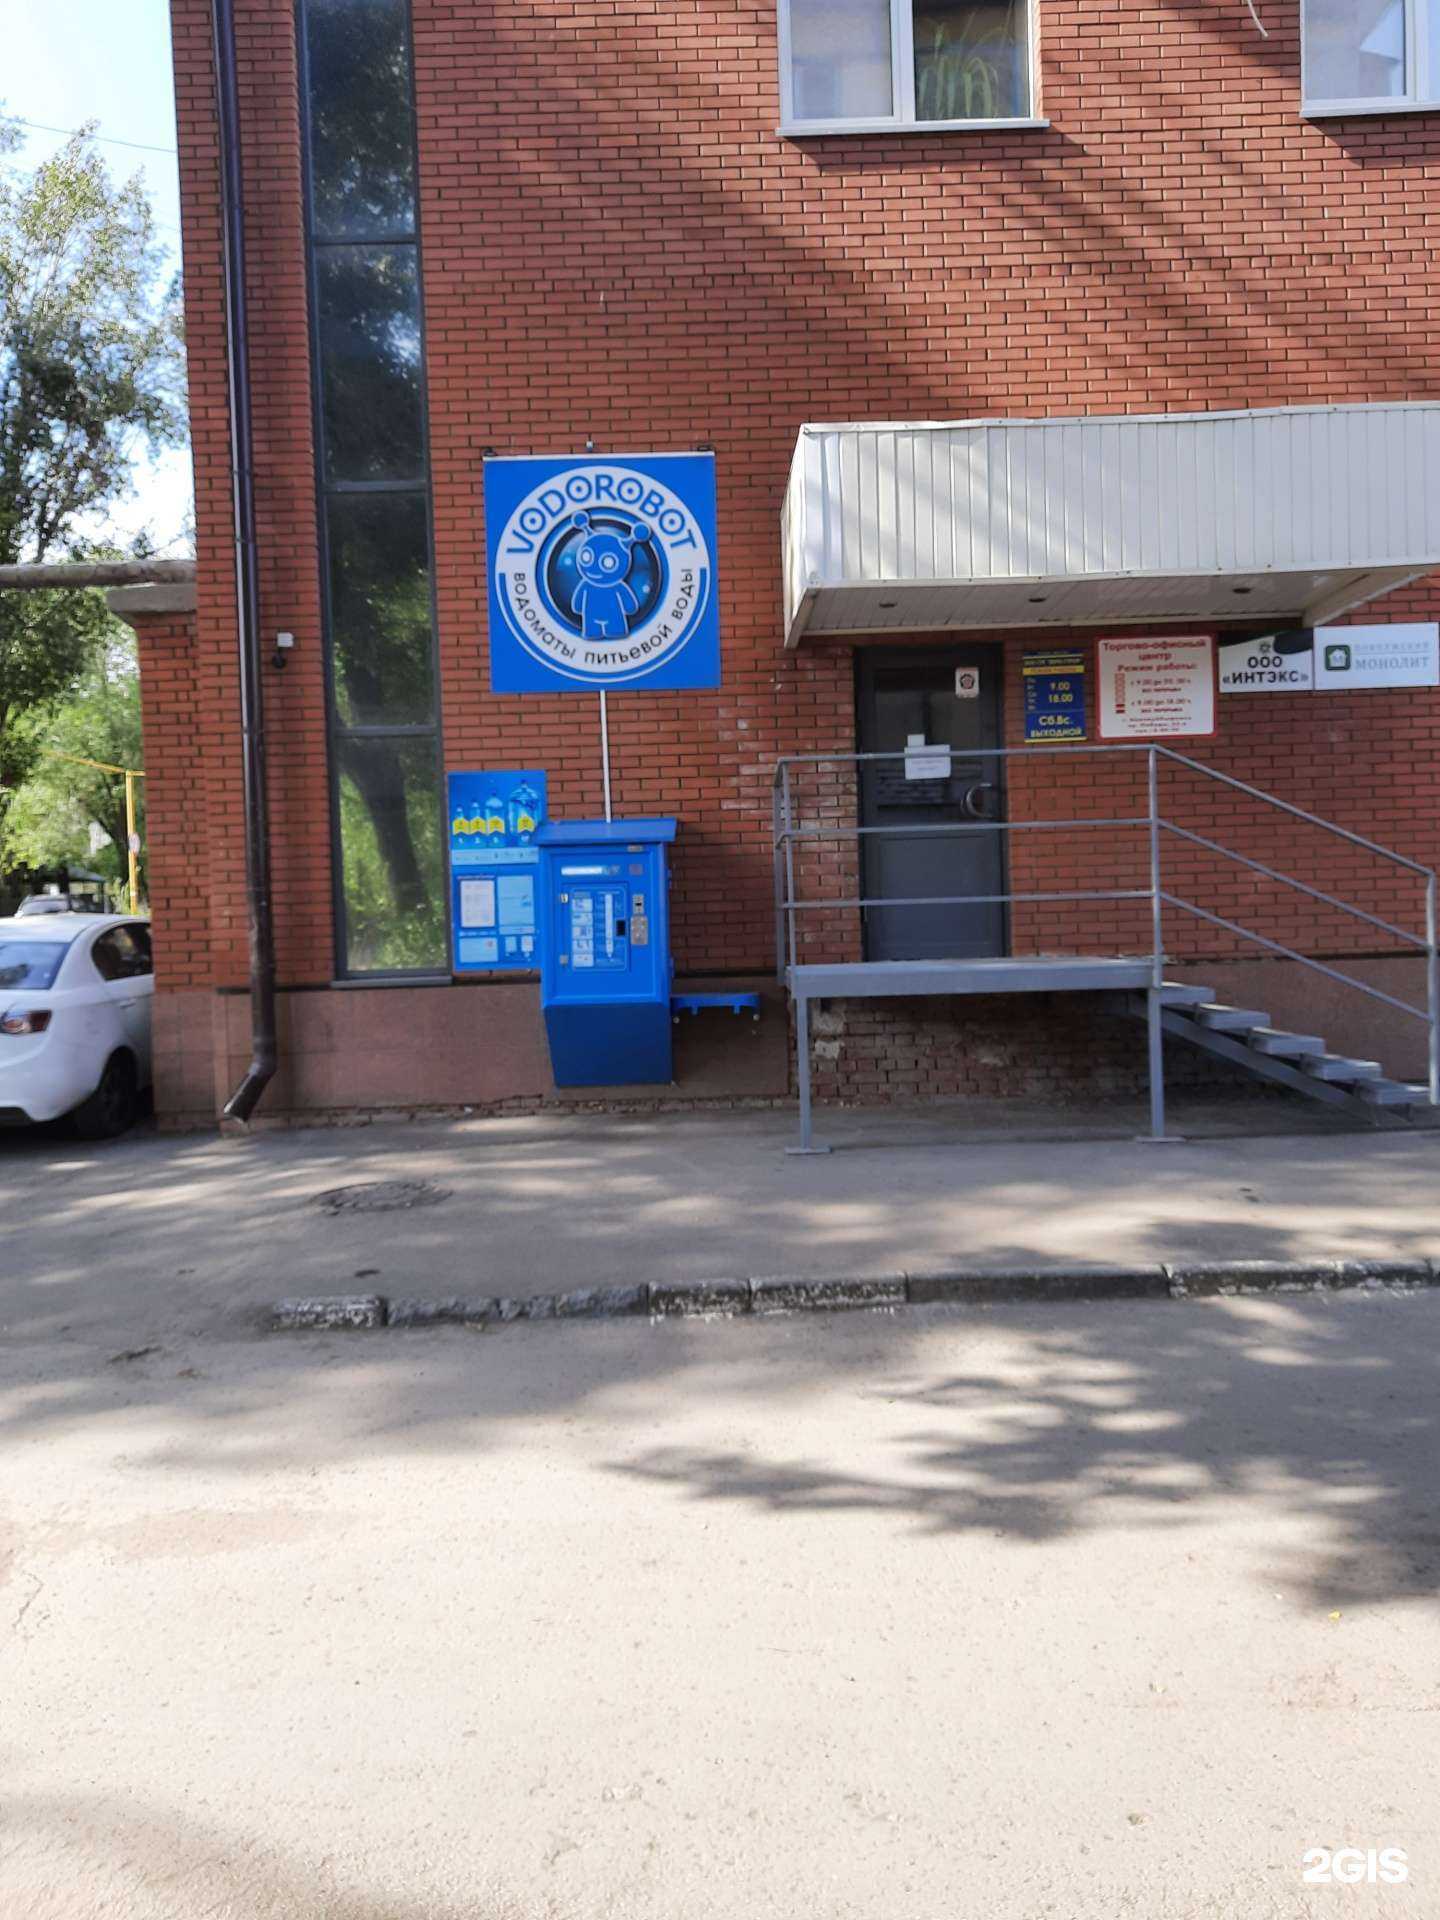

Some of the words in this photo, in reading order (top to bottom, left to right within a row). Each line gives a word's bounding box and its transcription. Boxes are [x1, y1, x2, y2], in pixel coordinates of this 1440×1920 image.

[506, 474, 698, 554] VODOROBOT
[1247, 655, 1283, 668] ООО
[1355, 656, 1429, 670] МОНОЛИТ
[1222, 670, 1309, 684] «ИНТЭКС»
